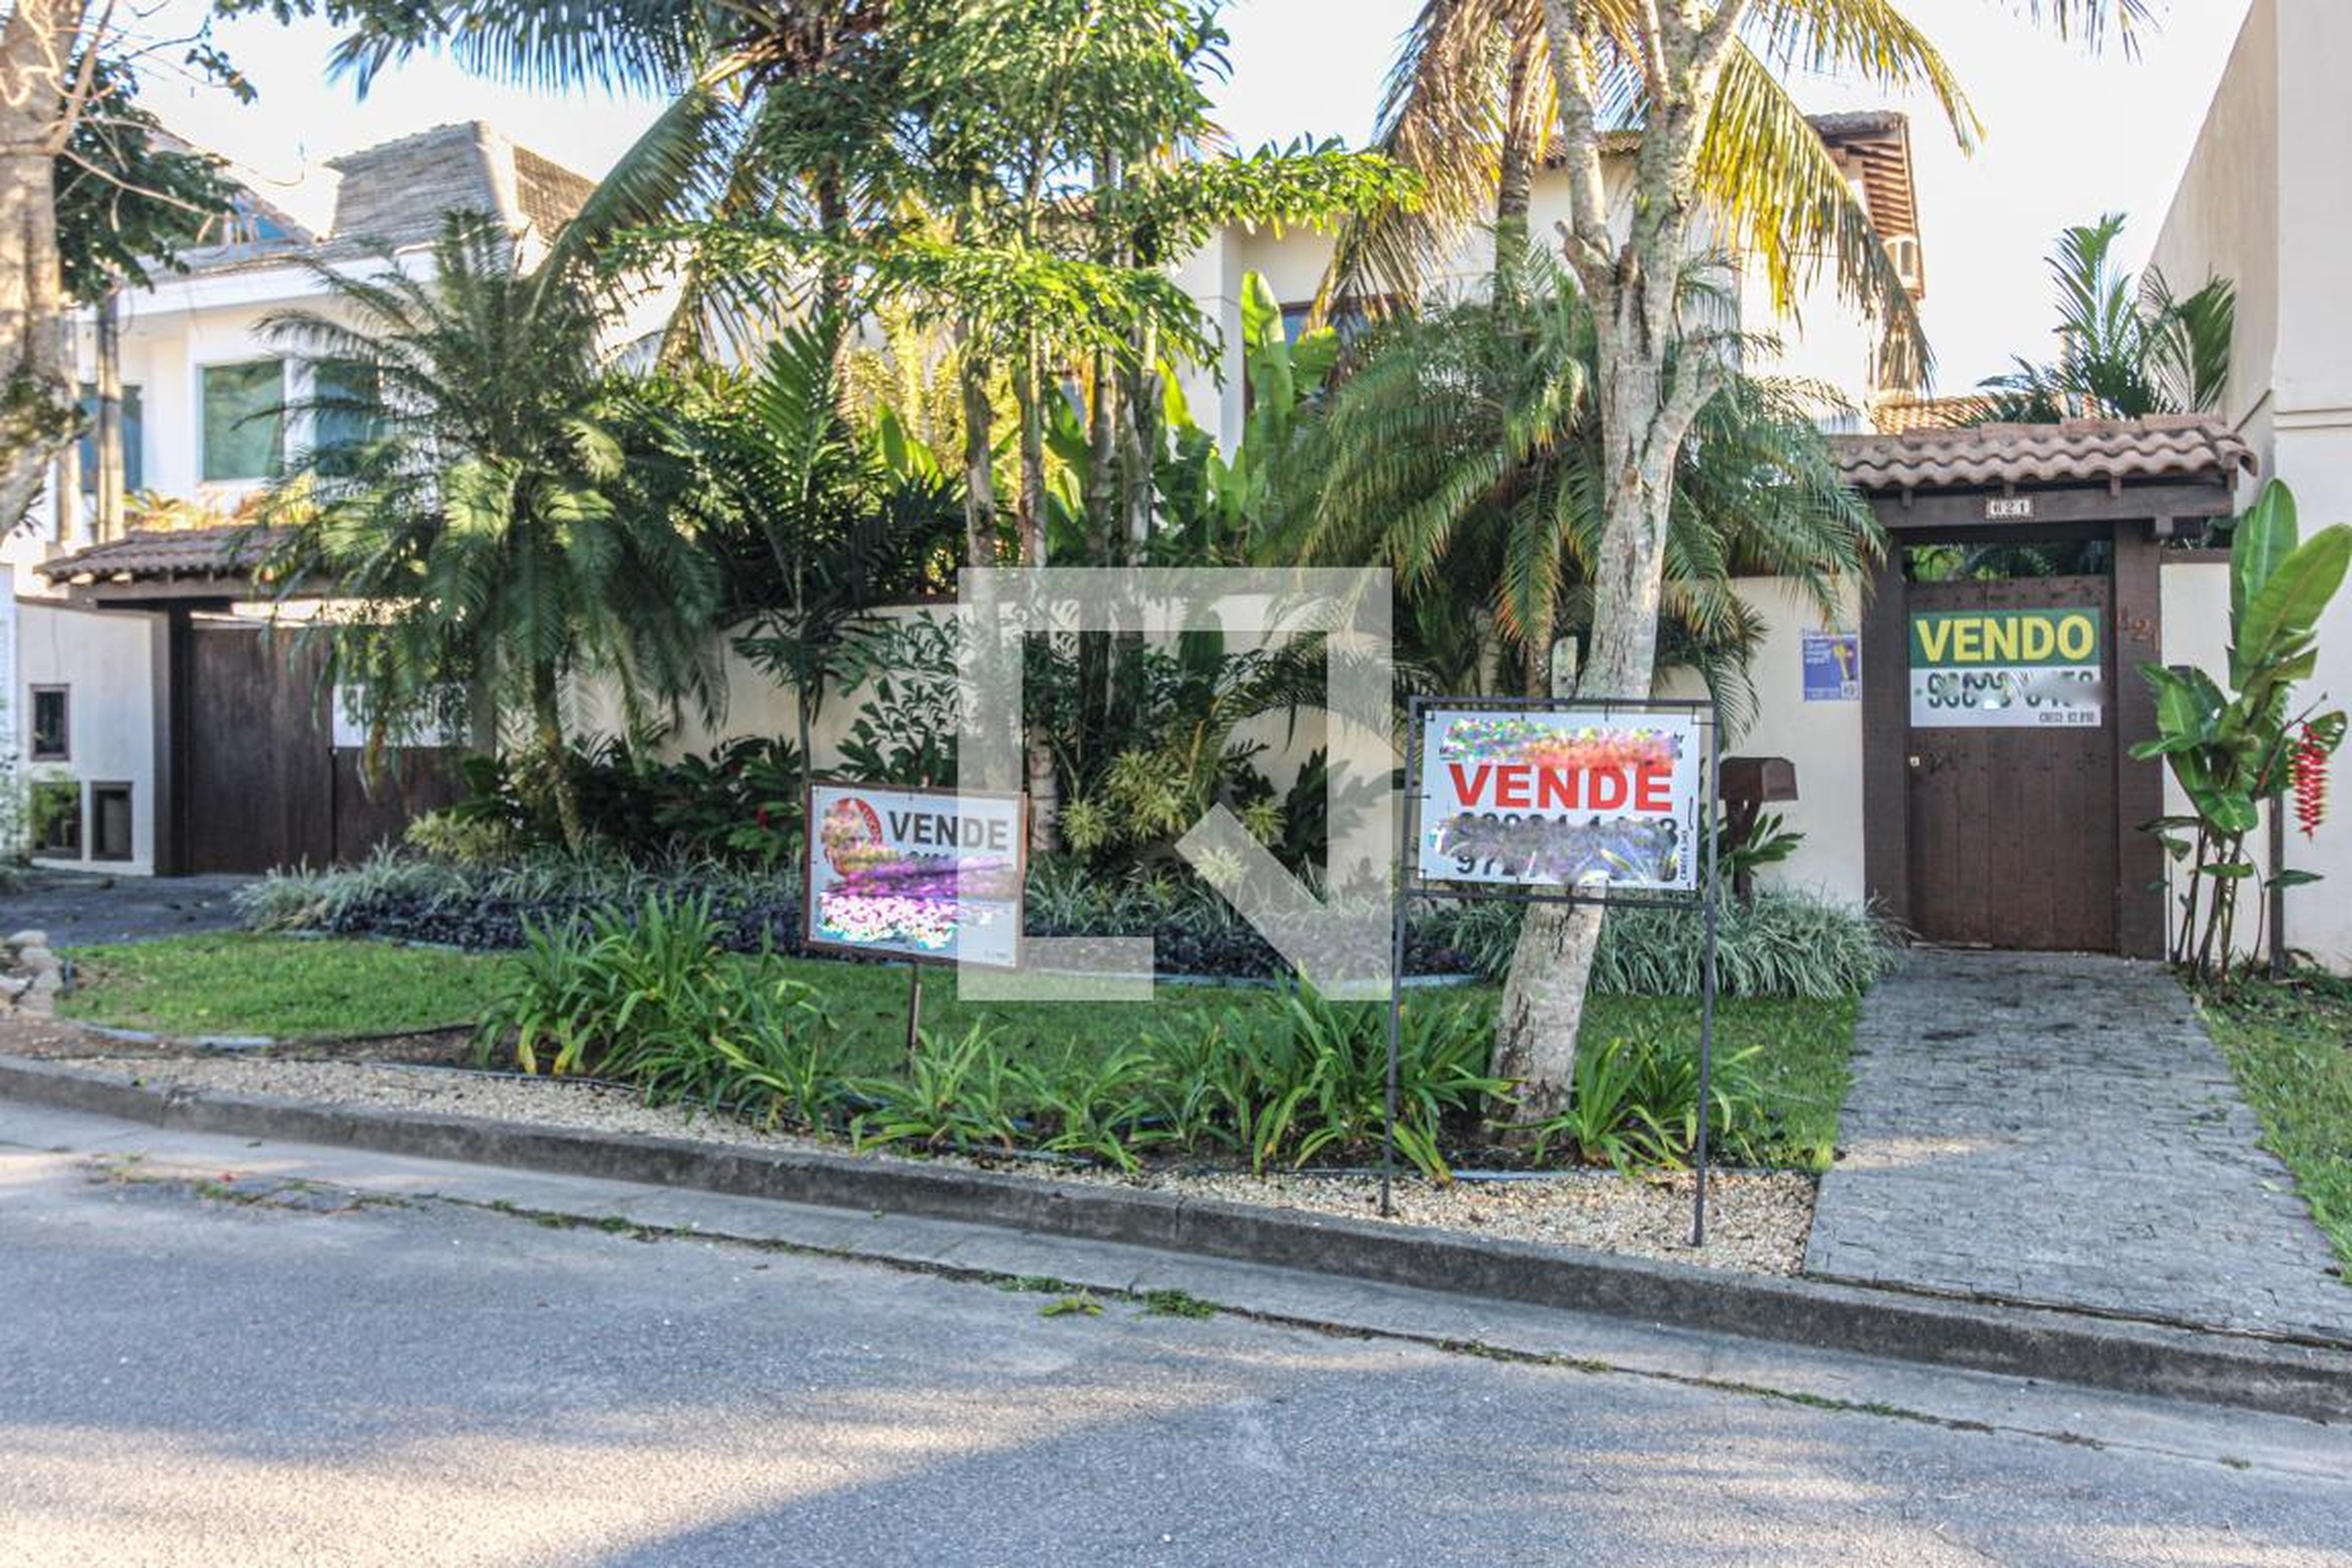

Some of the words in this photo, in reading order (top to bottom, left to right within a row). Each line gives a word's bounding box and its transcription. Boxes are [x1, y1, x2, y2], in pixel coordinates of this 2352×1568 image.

[1916, 615, 2093, 662] VENDO
[1449, 763, 1673, 812] VENDE
[888, 810, 1008, 851] VENDE
